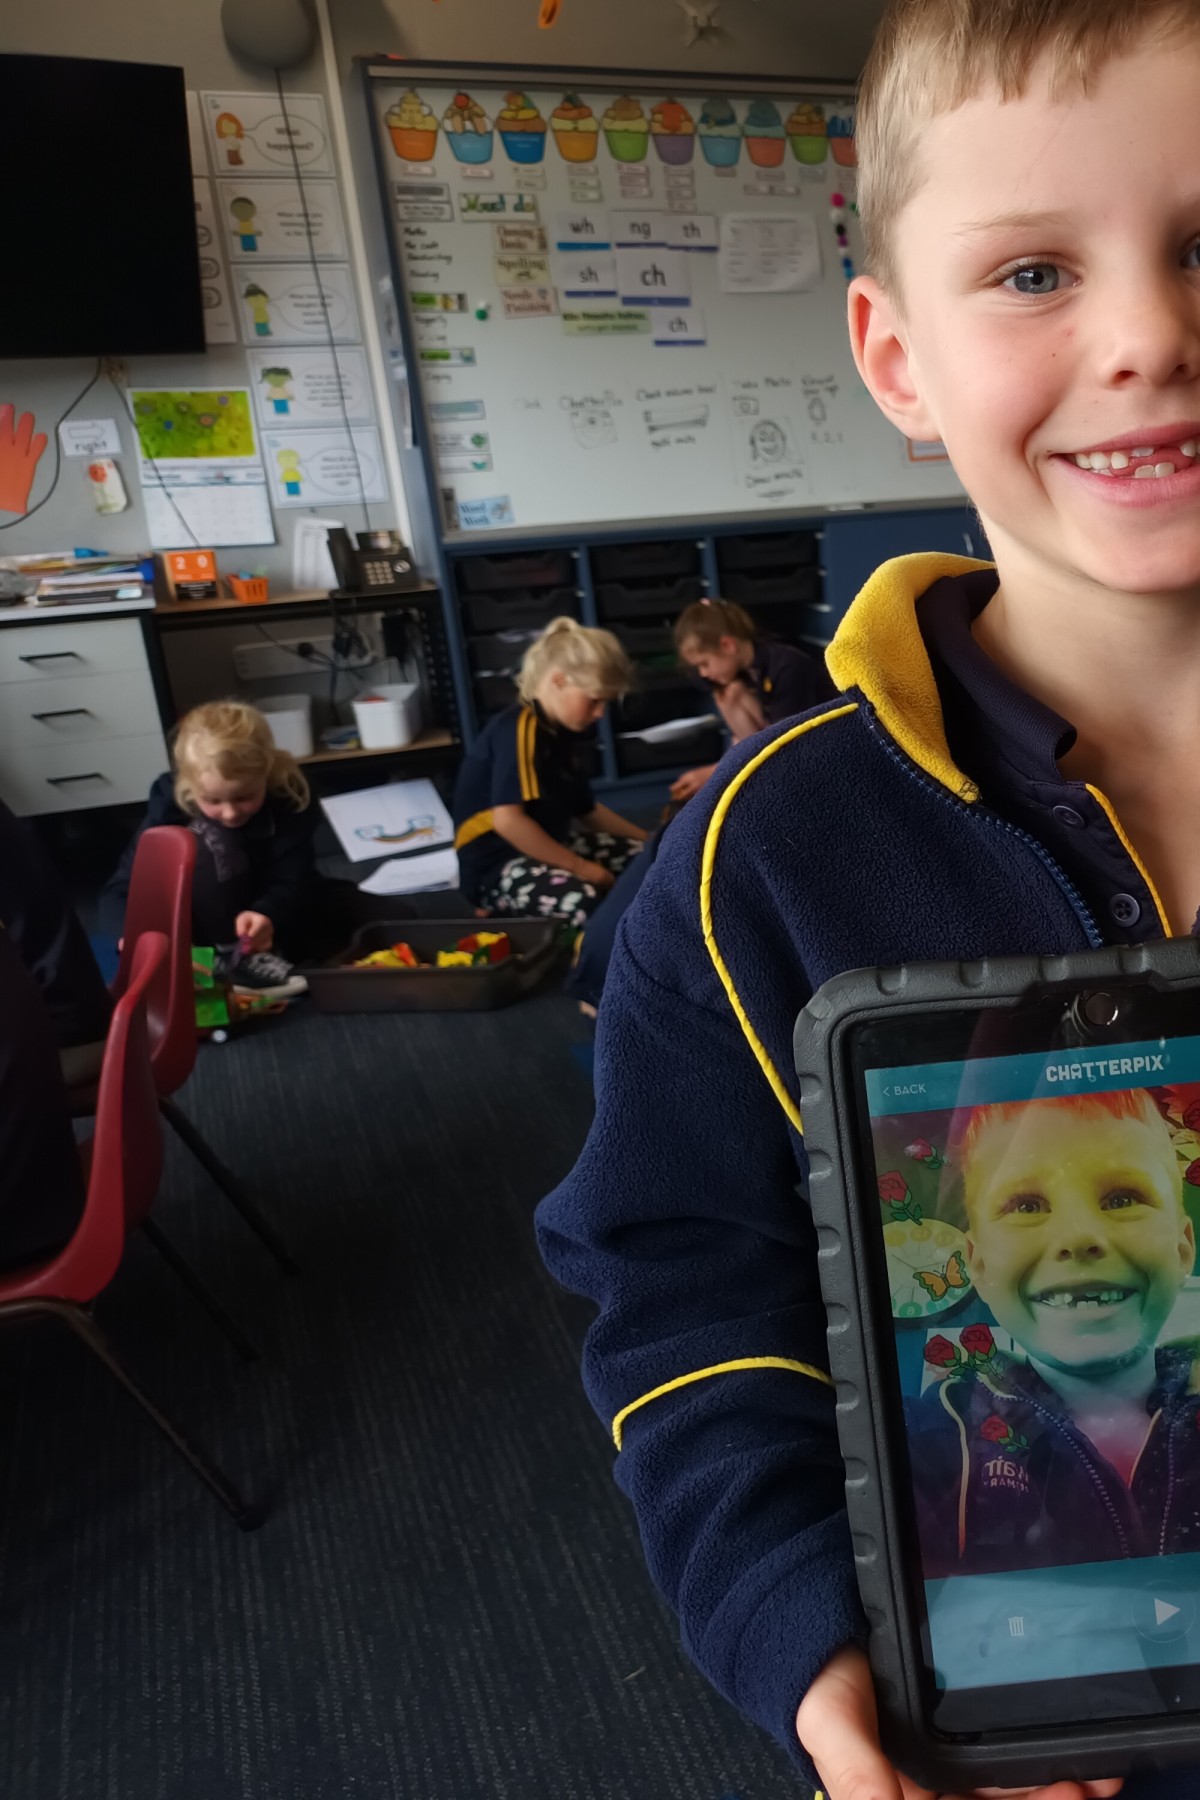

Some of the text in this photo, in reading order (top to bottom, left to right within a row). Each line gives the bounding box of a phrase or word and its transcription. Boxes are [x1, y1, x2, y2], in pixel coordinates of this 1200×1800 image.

[569, 216, 596, 235] wh
[629, 220, 652, 239] ng
[682, 222, 702, 239] th
[578, 266, 599, 283] sh
[640, 262, 667, 287] ch
[667, 316, 688, 333] ch
[1045, 1054, 1165, 1082] CHATTERPIX
[894, 1083, 926, 1096] BACK
